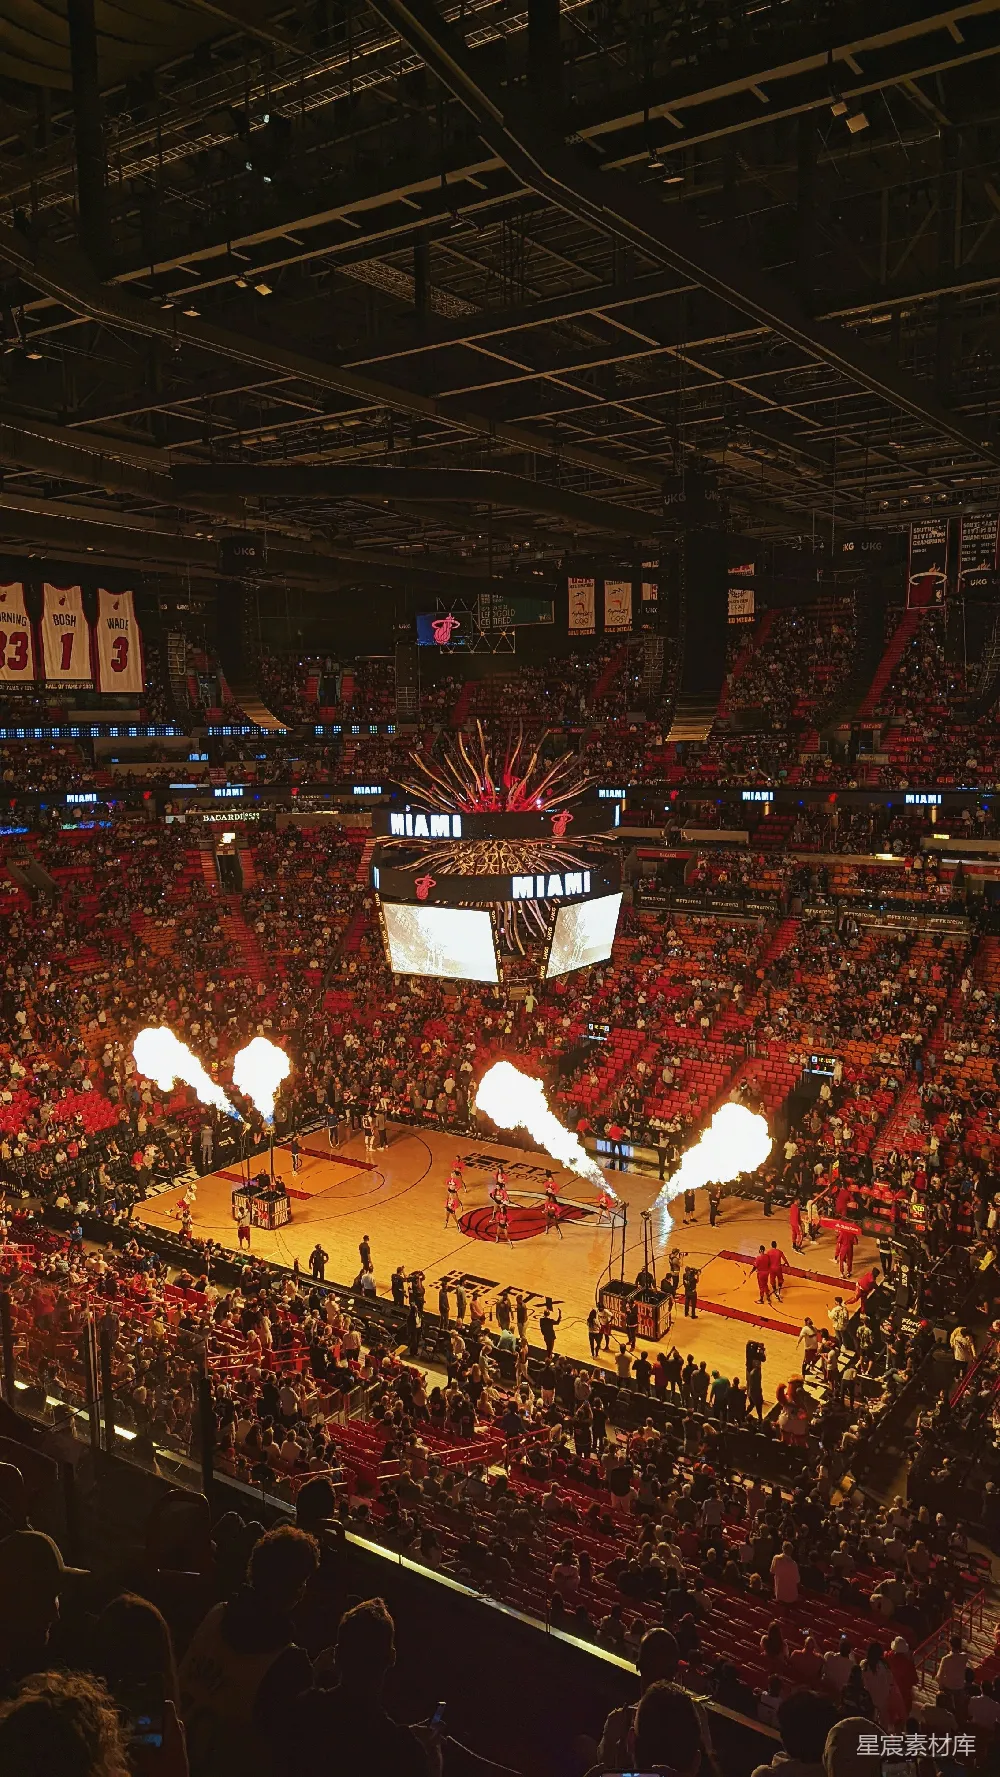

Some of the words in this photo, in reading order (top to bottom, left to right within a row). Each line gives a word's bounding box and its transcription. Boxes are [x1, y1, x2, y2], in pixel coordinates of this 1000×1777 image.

[233, 546, 256, 556] UKG
[861, 542, 883, 551] UKG
[970, 578, 988, 588] UKG
[52, 613, 77, 627] BOSH
[106, 618, 129, 630] WADE
[60, 632, 74, 670] 1
[110, 636, 129, 673] 3
[214, 788, 243, 797] MIAMI
[353, 786, 382, 795] MIAMI
[598, 789, 626, 798] MIAMI
[742, 791, 774, 801] MIAMI
[66, 793, 98, 803] MIAMI
[905, 794, 942, 804] MIAMI
[390, 812, 462, 838] MIAMI
[512, 869, 591, 899] MIAMI
[508, 1162, 561, 1177] FTX
[497, 1285, 565, 1312] FTX
[603, 1294, 622, 1311] MAKE
[901, 1317, 921, 1328] Flori
